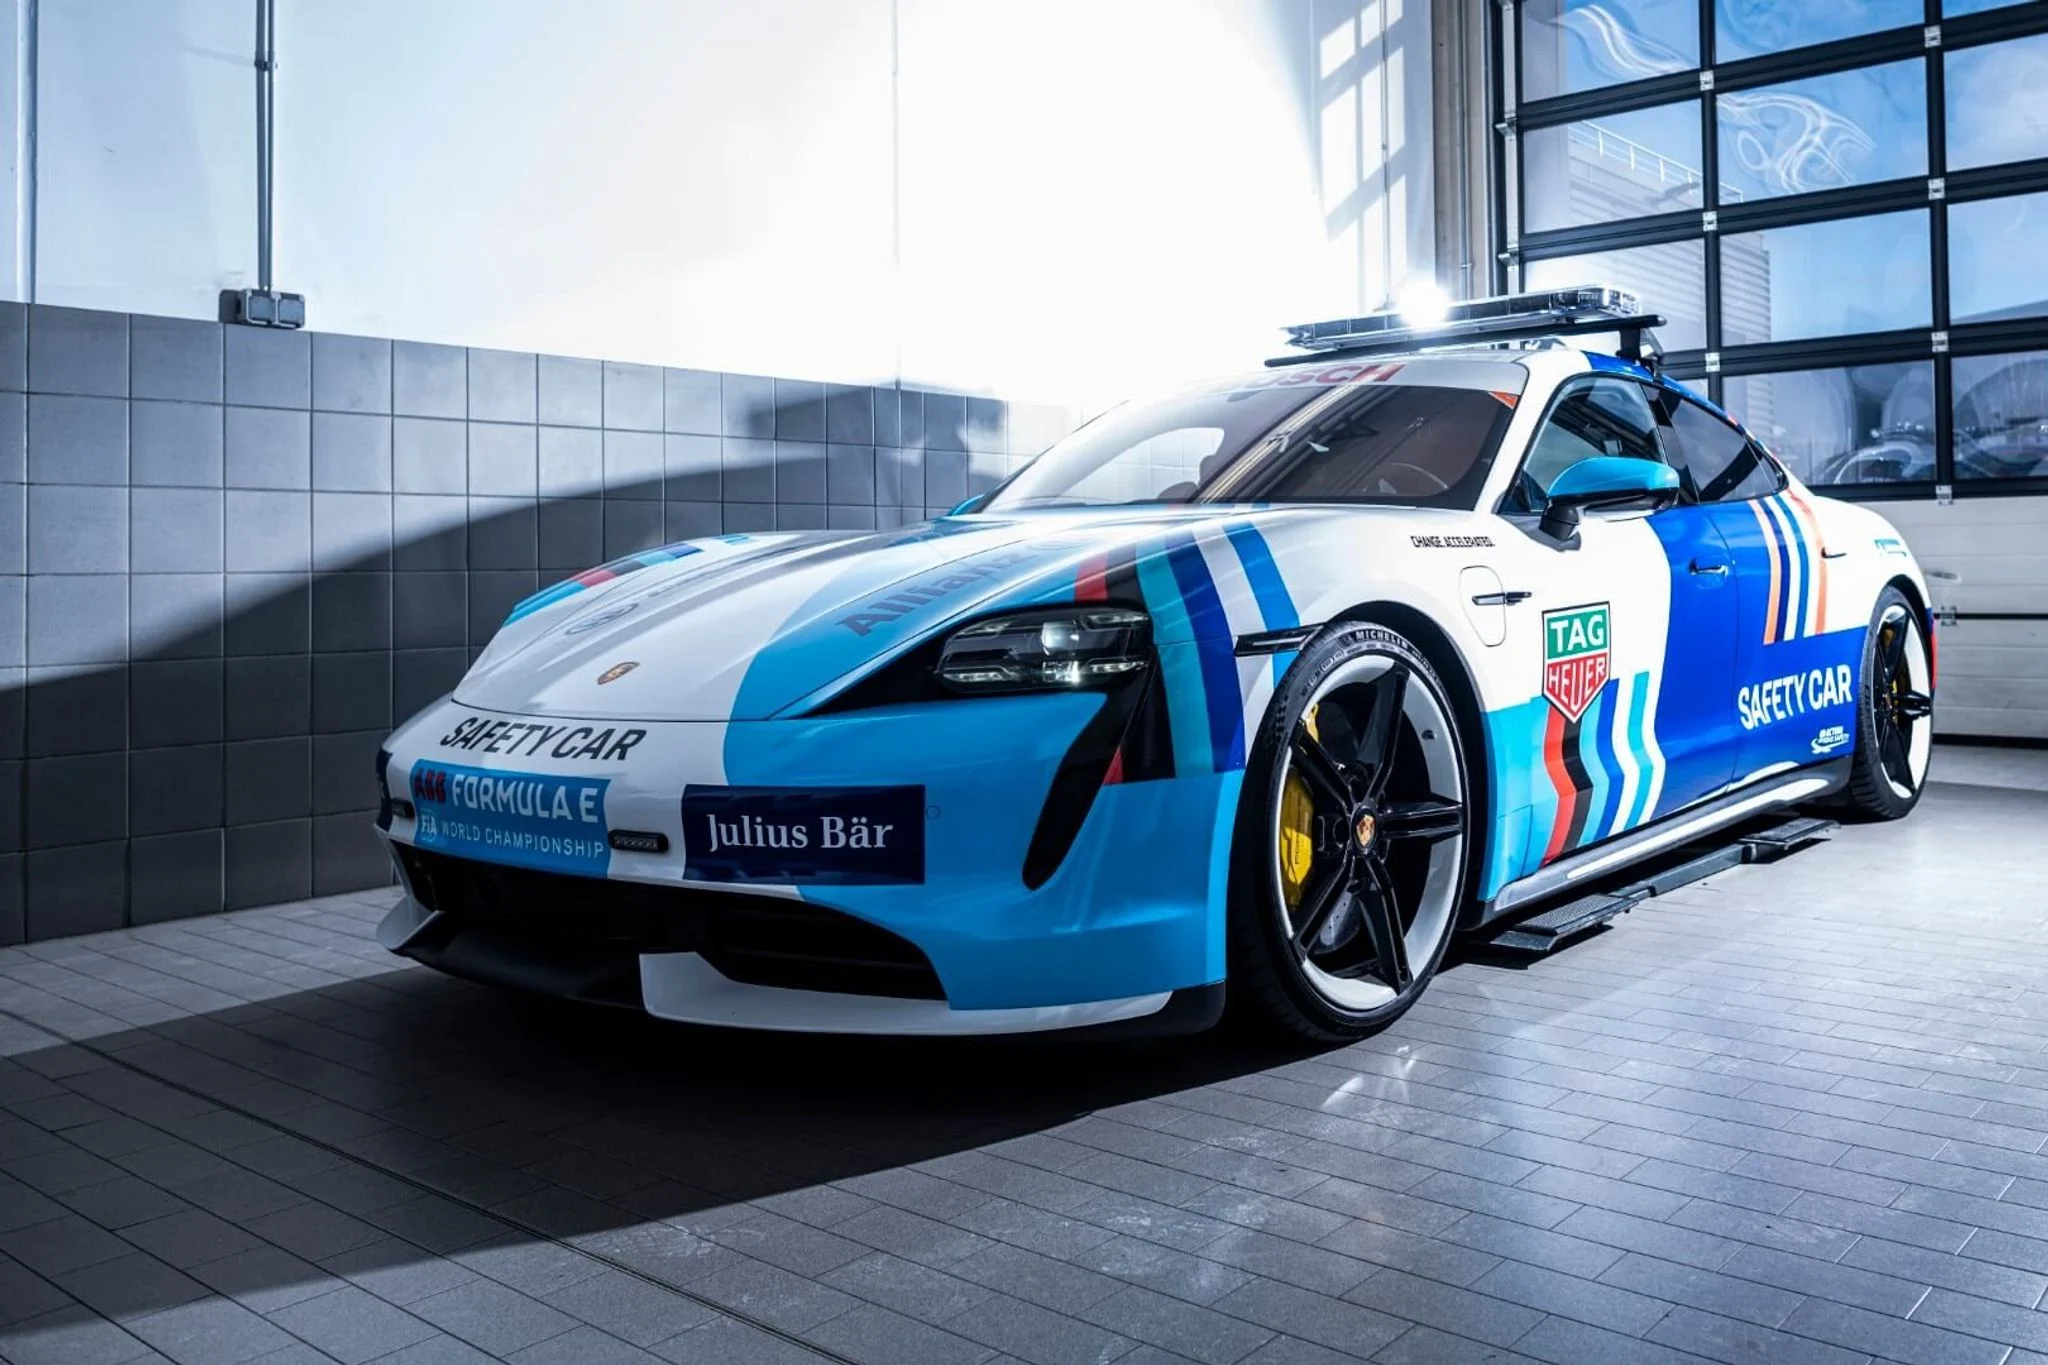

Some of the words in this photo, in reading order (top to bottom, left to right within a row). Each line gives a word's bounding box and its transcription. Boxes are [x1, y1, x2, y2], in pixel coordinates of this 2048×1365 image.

[1244, 364, 1406, 389] OSCH
[836, 552, 1038, 637] Allianz
[1355, 628, 1409, 650] MICHELIN
[1550, 614, 1605, 654] TAG
[1548, 657, 1606, 712] HEUER
[1738, 672, 1807, 730] SAFETY
[1808, 663, 1853, 710] CAR
[440, 716, 560, 758] SAFETY
[551, 725, 647, 762] CAR
[414, 767, 447, 804] ABB
[451, 773, 573, 821] FORMULA
[579, 787, 599, 824] E
[420, 813, 438, 836] FIA
[441, 819, 481, 842] WORLD
[485, 827, 604, 858] CHAMPIONSHIP
[707, 813, 809, 853] Julius
[820, 809, 895, 850] Bär
